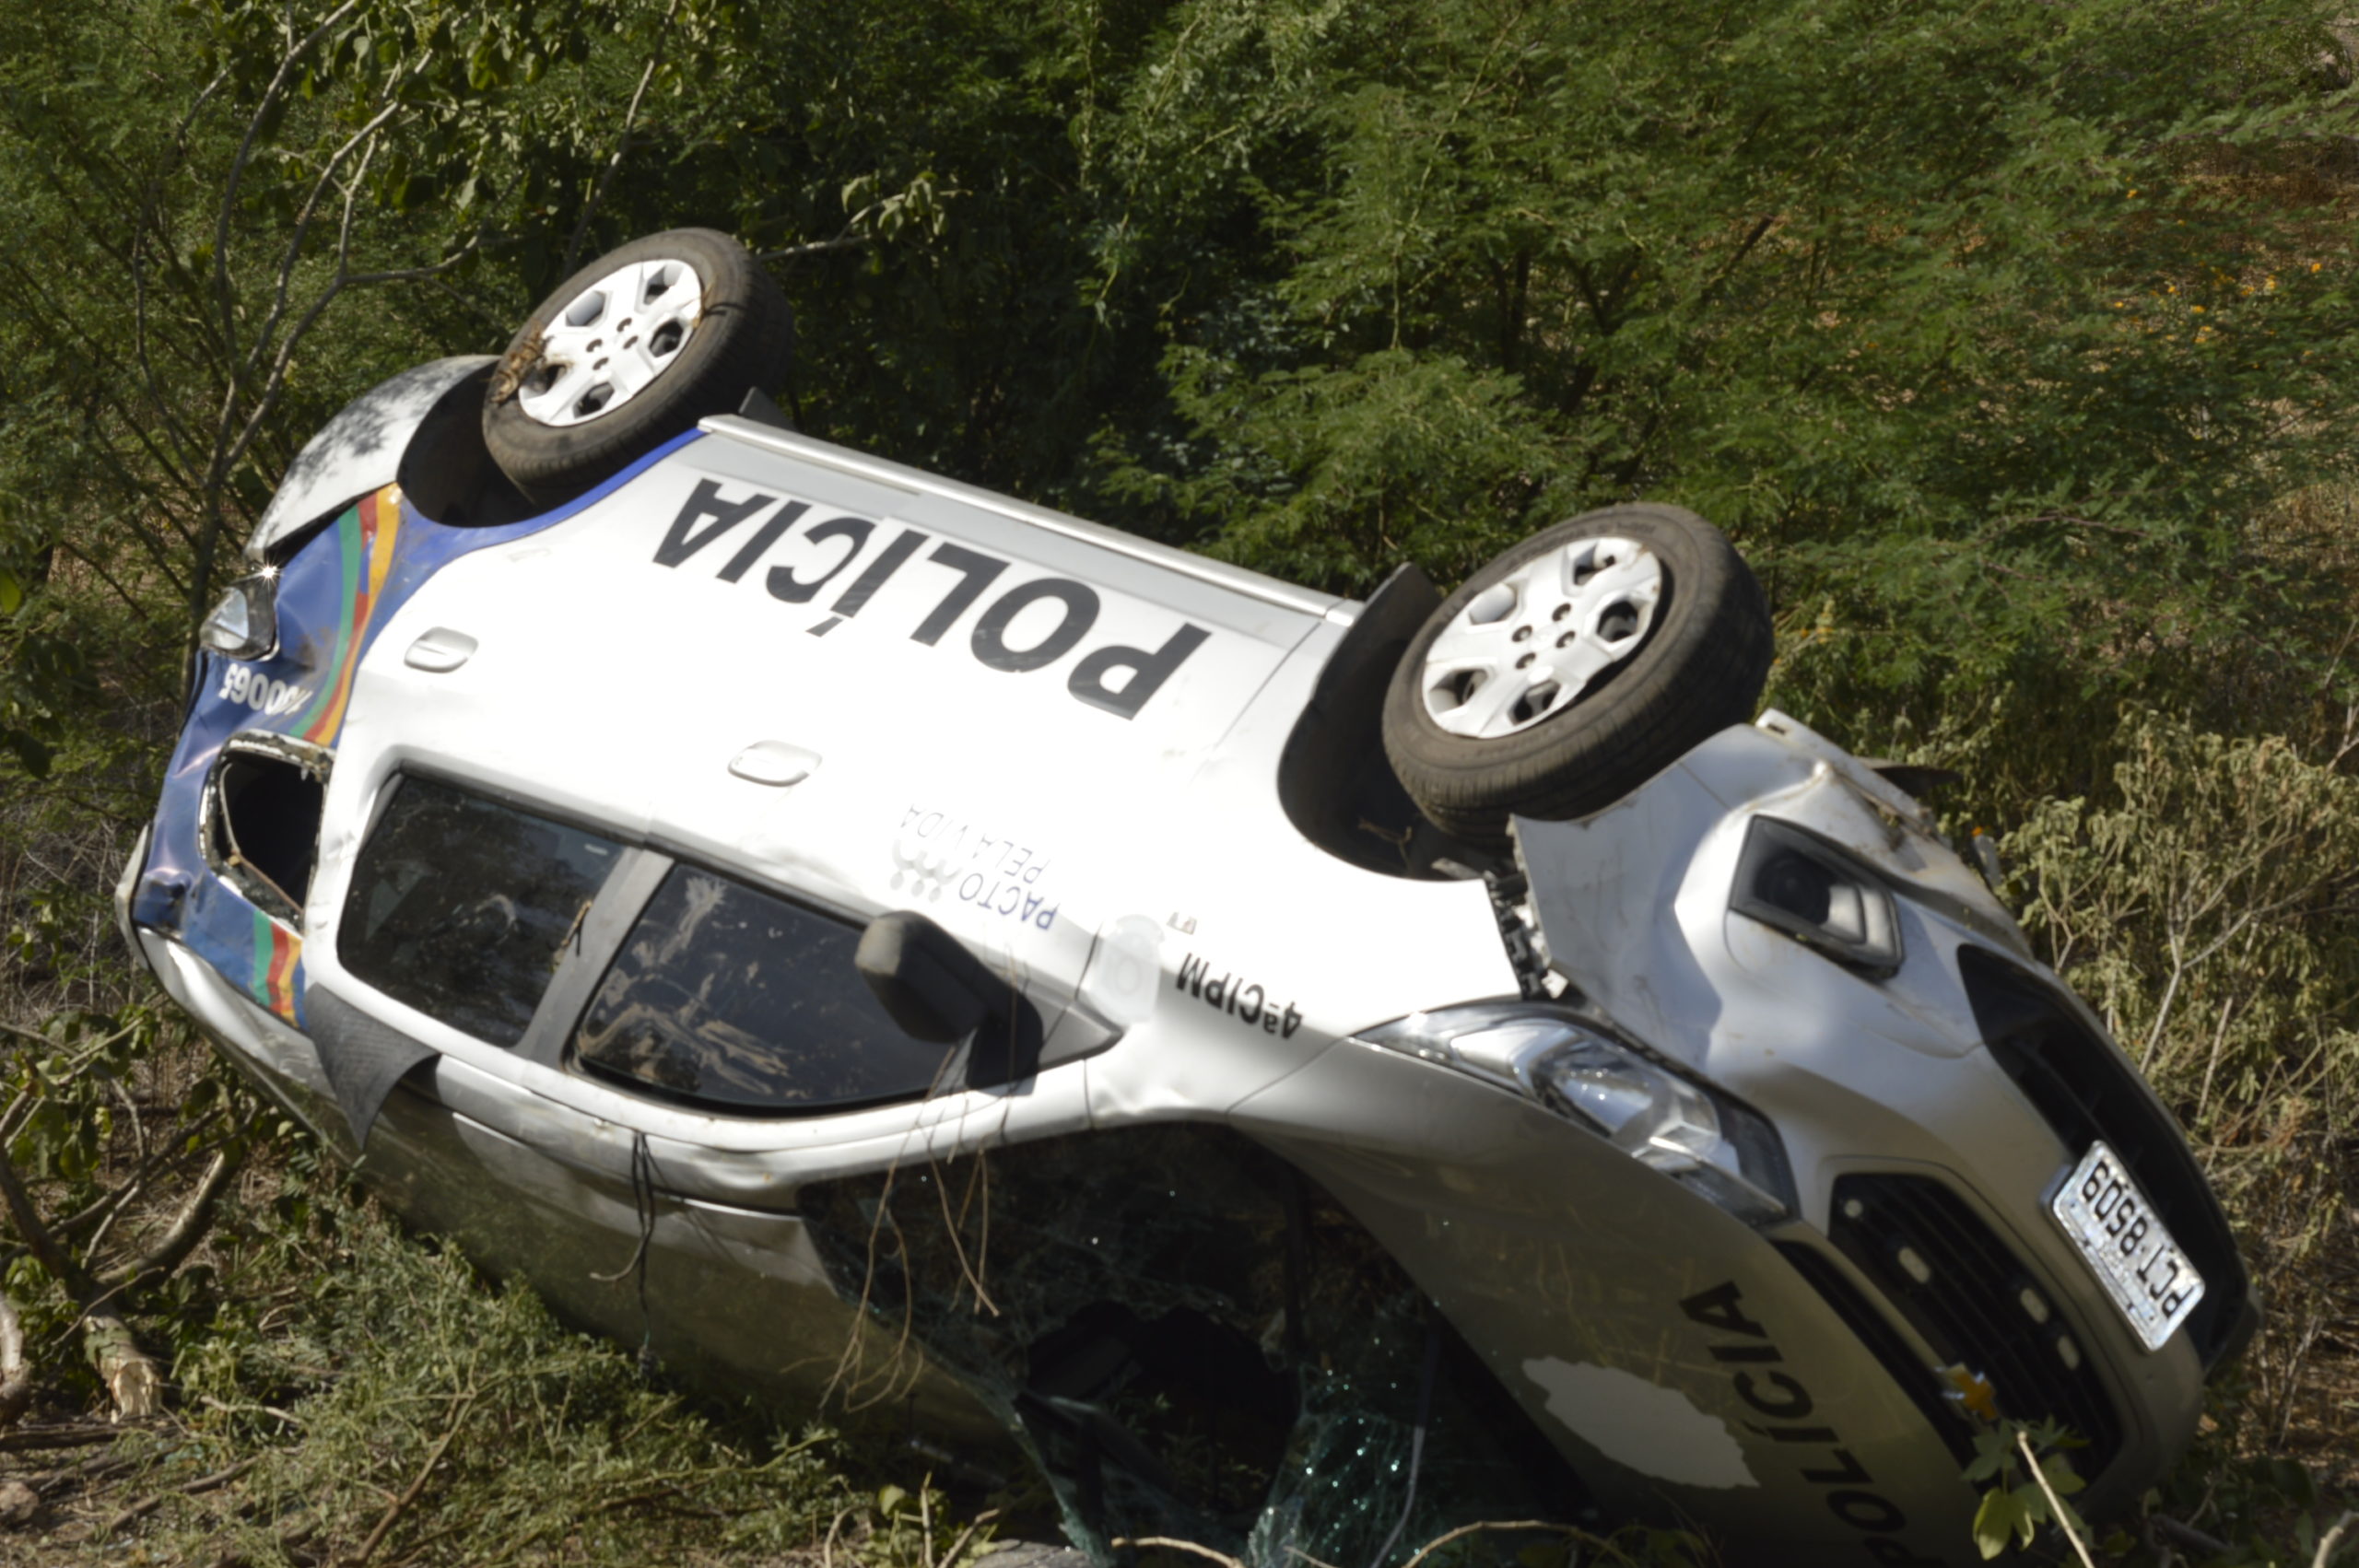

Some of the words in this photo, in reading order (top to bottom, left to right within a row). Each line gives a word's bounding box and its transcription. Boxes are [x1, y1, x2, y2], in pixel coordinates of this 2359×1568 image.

[651, 477, 1214, 721] POLÍCIA
[900, 803, 969, 850] VIDA
[971, 834, 1050, 884] PELA
[958, 872, 1061, 930] PACTO
[1679, 1281, 1946, 1568] POLÍCIA
